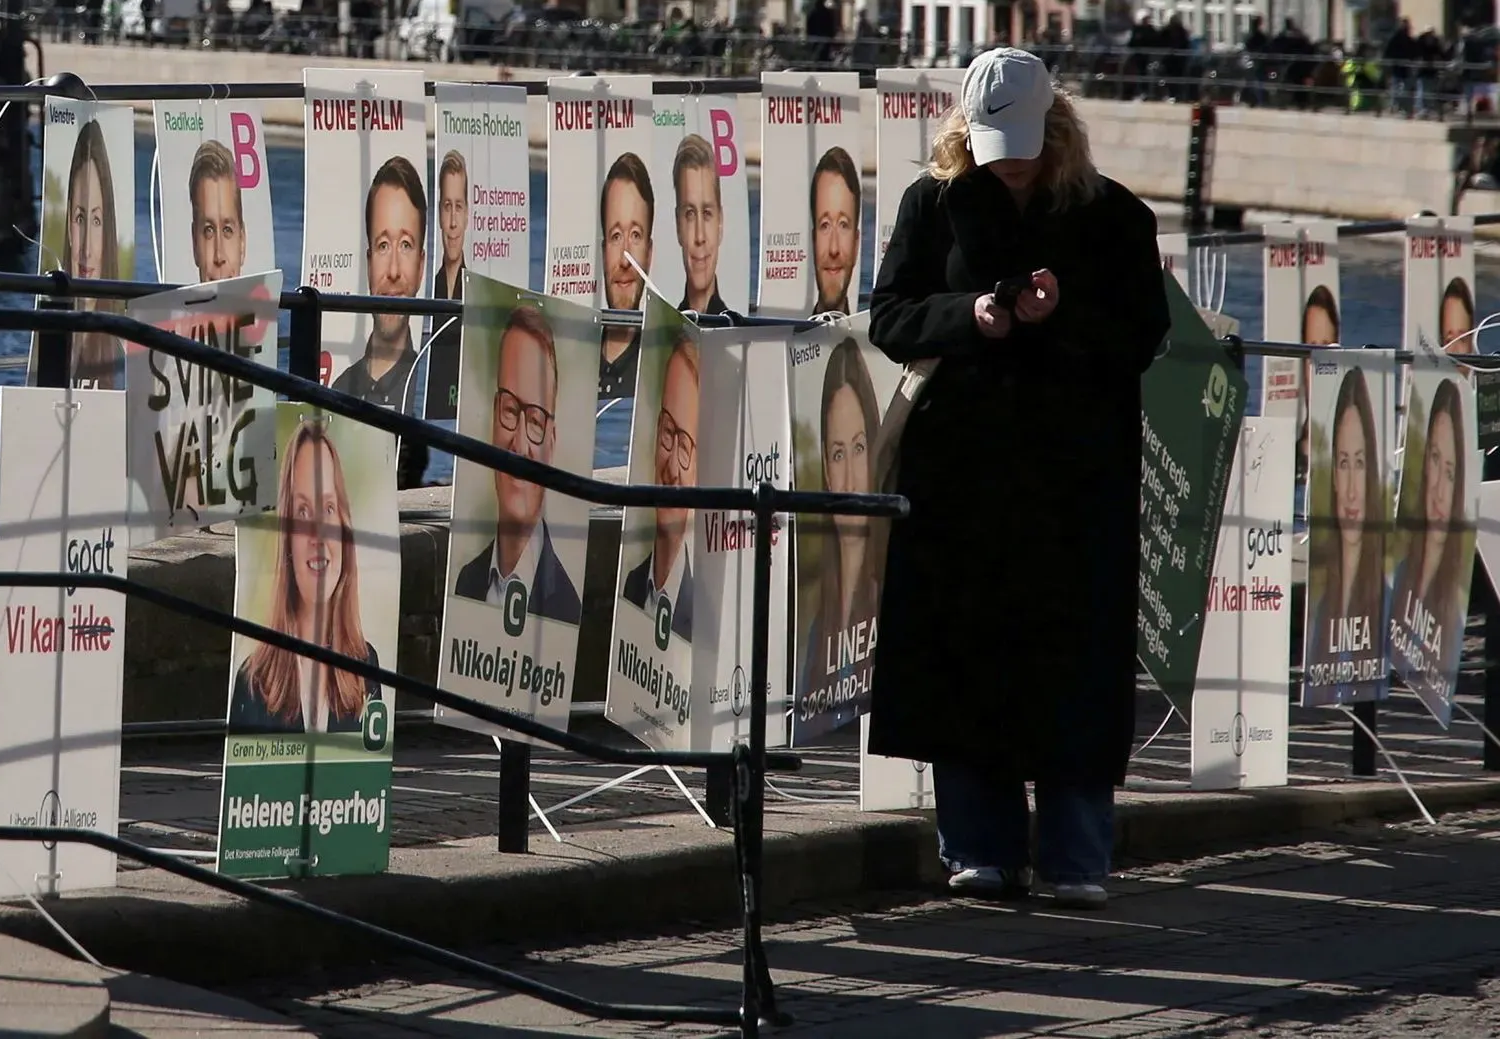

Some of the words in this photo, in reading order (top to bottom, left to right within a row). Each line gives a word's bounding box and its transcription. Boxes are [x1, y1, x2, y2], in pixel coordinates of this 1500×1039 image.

[50, 104, 75, 125] Venstre
[313, 100, 356, 130] RUNE
[361, 100, 403, 130] PALM
[555, 102, 592, 130] RUNE
[597, 100, 633, 128] PALM
[769, 96, 802, 124] RUNE
[807, 97, 841, 124] PALM
[884, 92, 916, 119] RUNE
[164, 111, 204, 131] Radikale
[443, 110, 481, 136] Thomas
[483, 113, 521, 137] Rohden
[230, 112, 261, 189] B
[709, 109, 738, 177] B
[473, 185, 488, 205] Din
[489, 187, 525, 206] stemme
[473, 212, 486, 231] for
[488, 216, 499, 231] en
[500, 212, 526, 232] bedre
[319, 254, 332, 268] KAN
[334, 253, 353, 268] GODT
[473, 238, 510, 261] psykiatri
[1269, 244, 1296, 268] RUNE
[1298, 241, 1325, 266] PALM
[1411, 236, 1436, 259] RUNE
[1438, 235, 1462, 258] PALM
[309, 269, 318, 287] FÅ
[320, 273, 332, 287] TID
[562, 263, 579, 277] BØRN
[581, 263, 590, 276] UD
[552, 281, 560, 296] AF
[561, 279, 597, 295] FATTIGDOM
[790, 342, 820, 367] Venstre
[154, 409, 257, 510] VALG
[1161, 446, 1190, 500] tredje
[1164, 493, 1179, 529] sig
[705, 511, 718, 553] Vi
[721, 511, 746, 552] kan
[1151, 514, 1173, 554] skat
[1171, 546, 1186, 572] på
[1247, 520, 1283, 570] godt
[67, 527, 114, 597] godt
[1150, 552, 1163, 576] af
[1222, 577, 1247, 612] kan
[1250, 576, 1281, 612] ikke
[6, 606, 26, 654] Vi
[30, 606, 65, 653] kan
[71, 604, 113, 652] ikke
[1329, 616, 1371, 653] LINEA
[1404, 589, 1442, 661] LINEA
[826, 616, 878, 675] LINEA
[450, 638, 517, 697] Nikolaj
[519, 655, 565, 706] Bøgh
[617, 639, 664, 709] Nikolaj
[233, 742, 253, 758] Grøn
[256, 742, 269, 760] by,
[271, 740, 284, 756] blå
[286, 743, 305, 756] søer
[63, 809, 97, 827] Alliance
[228, 794, 294, 828] Helene
[299, 789, 386, 835] Fagerhøj
[225, 849, 234, 860] Det
[236, 848, 271, 860] Konservative
